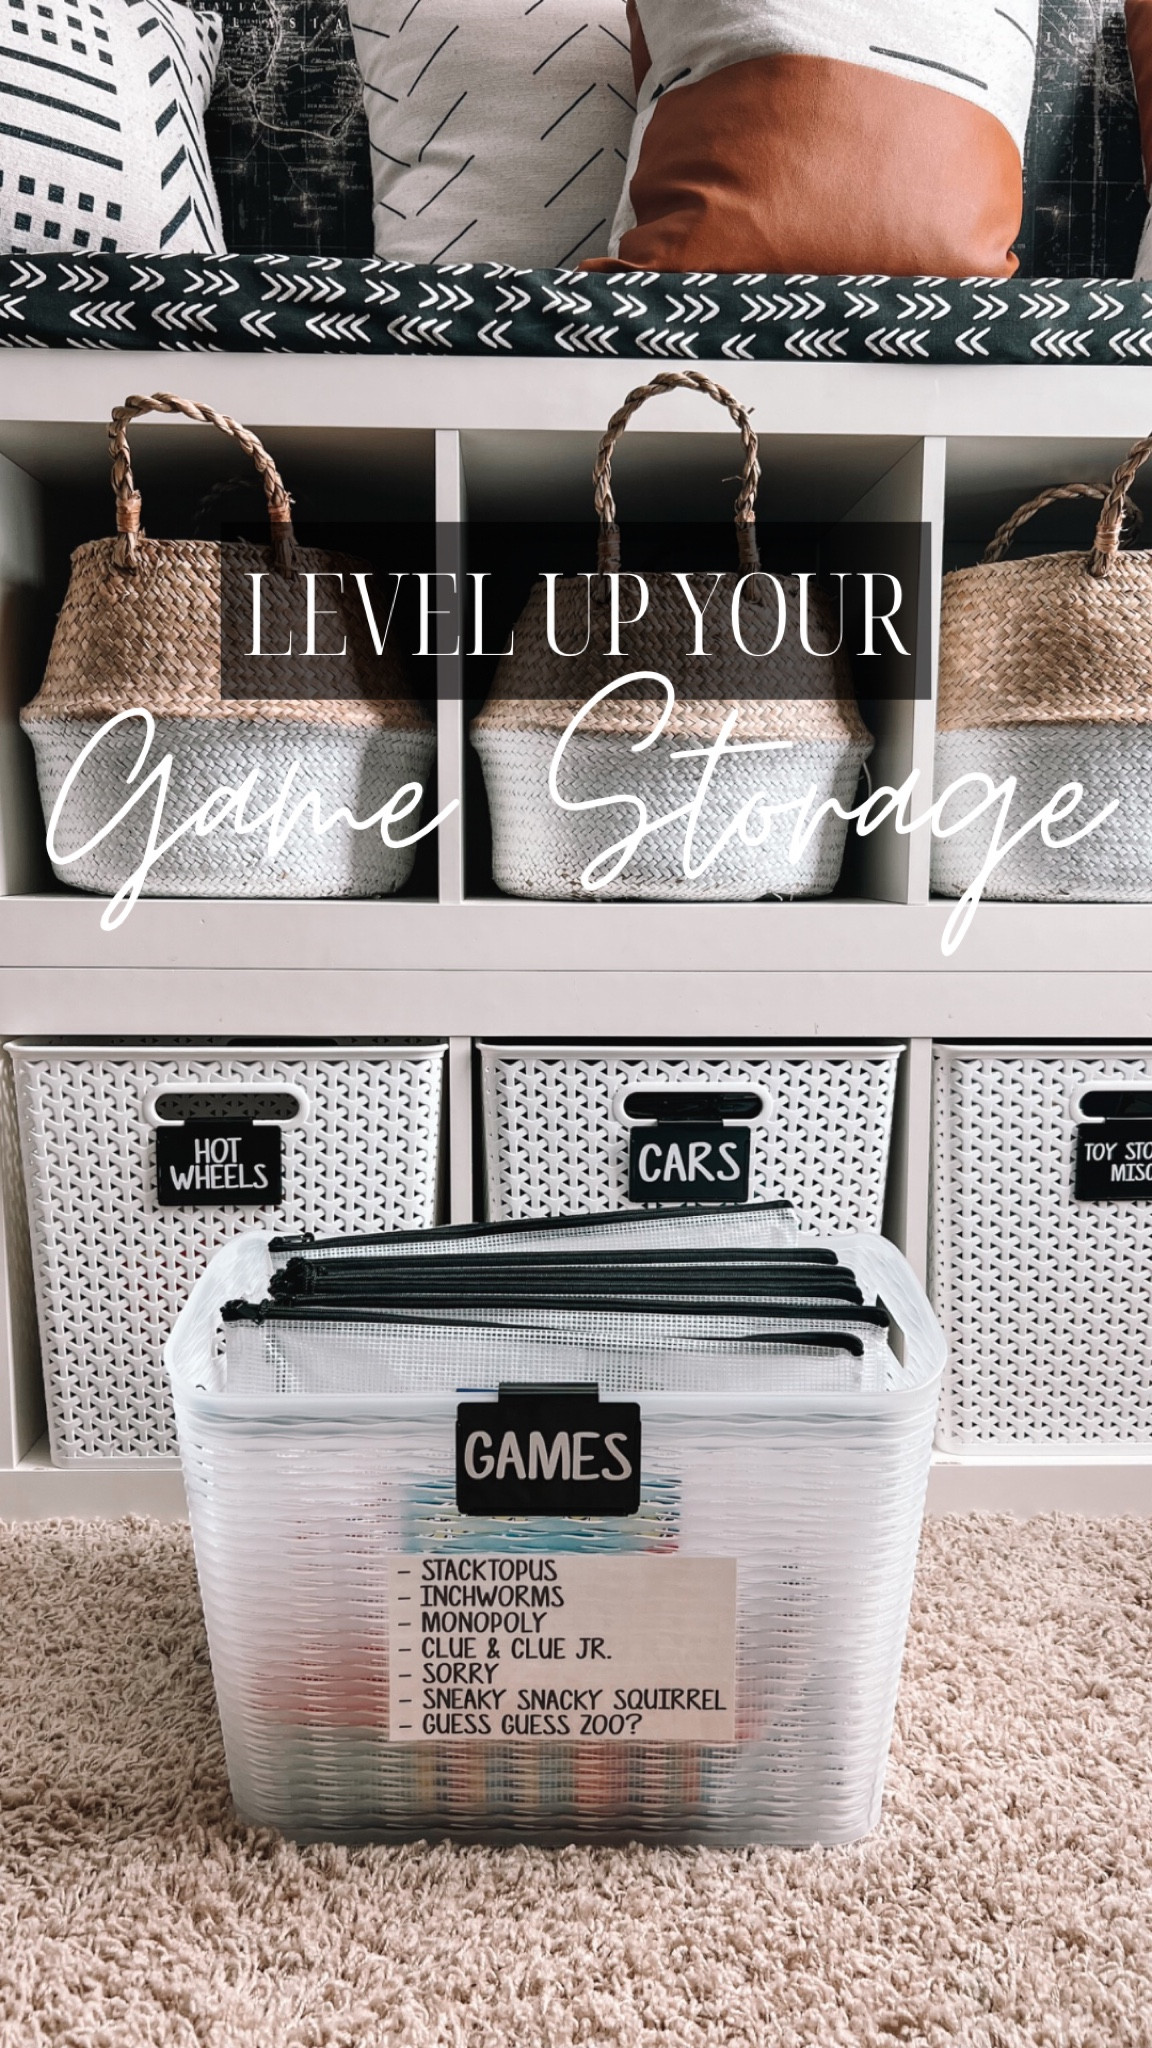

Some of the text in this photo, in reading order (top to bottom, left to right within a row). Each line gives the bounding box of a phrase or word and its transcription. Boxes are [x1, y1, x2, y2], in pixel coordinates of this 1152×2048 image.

[194, 1137, 242, 1164] HOT
[638, 1141, 741, 1183] CARS
[1084, 1142, 1119, 1162] TOY
[169, 1163, 269, 1191] WHEELS
[464, 1431, 633, 1482] GAMES
[421, 1558, 558, 1582] STACKTOPUS
[419, 1584, 565, 1608] INCHWORMS
[421, 1611, 548, 1634] MONOPOLY
[421, 1636, 477, 1659] CLUE
[486, 1637, 501, 1660] &
[511, 1637, 566, 1660] CLUE
[575, 1637, 612, 1660] JR.
[422, 1662, 500, 1685] SORRY
[422, 1687, 507, 1710] SNEAKY
[516, 1688, 604, 1711] SNACKY
[613, 1687, 727, 1711] SQUIRREL
[422, 1712, 492, 1735] GUESS
[501, 1713, 571, 1736] GUESS
[579, 1712, 643, 1736] ZOO?
